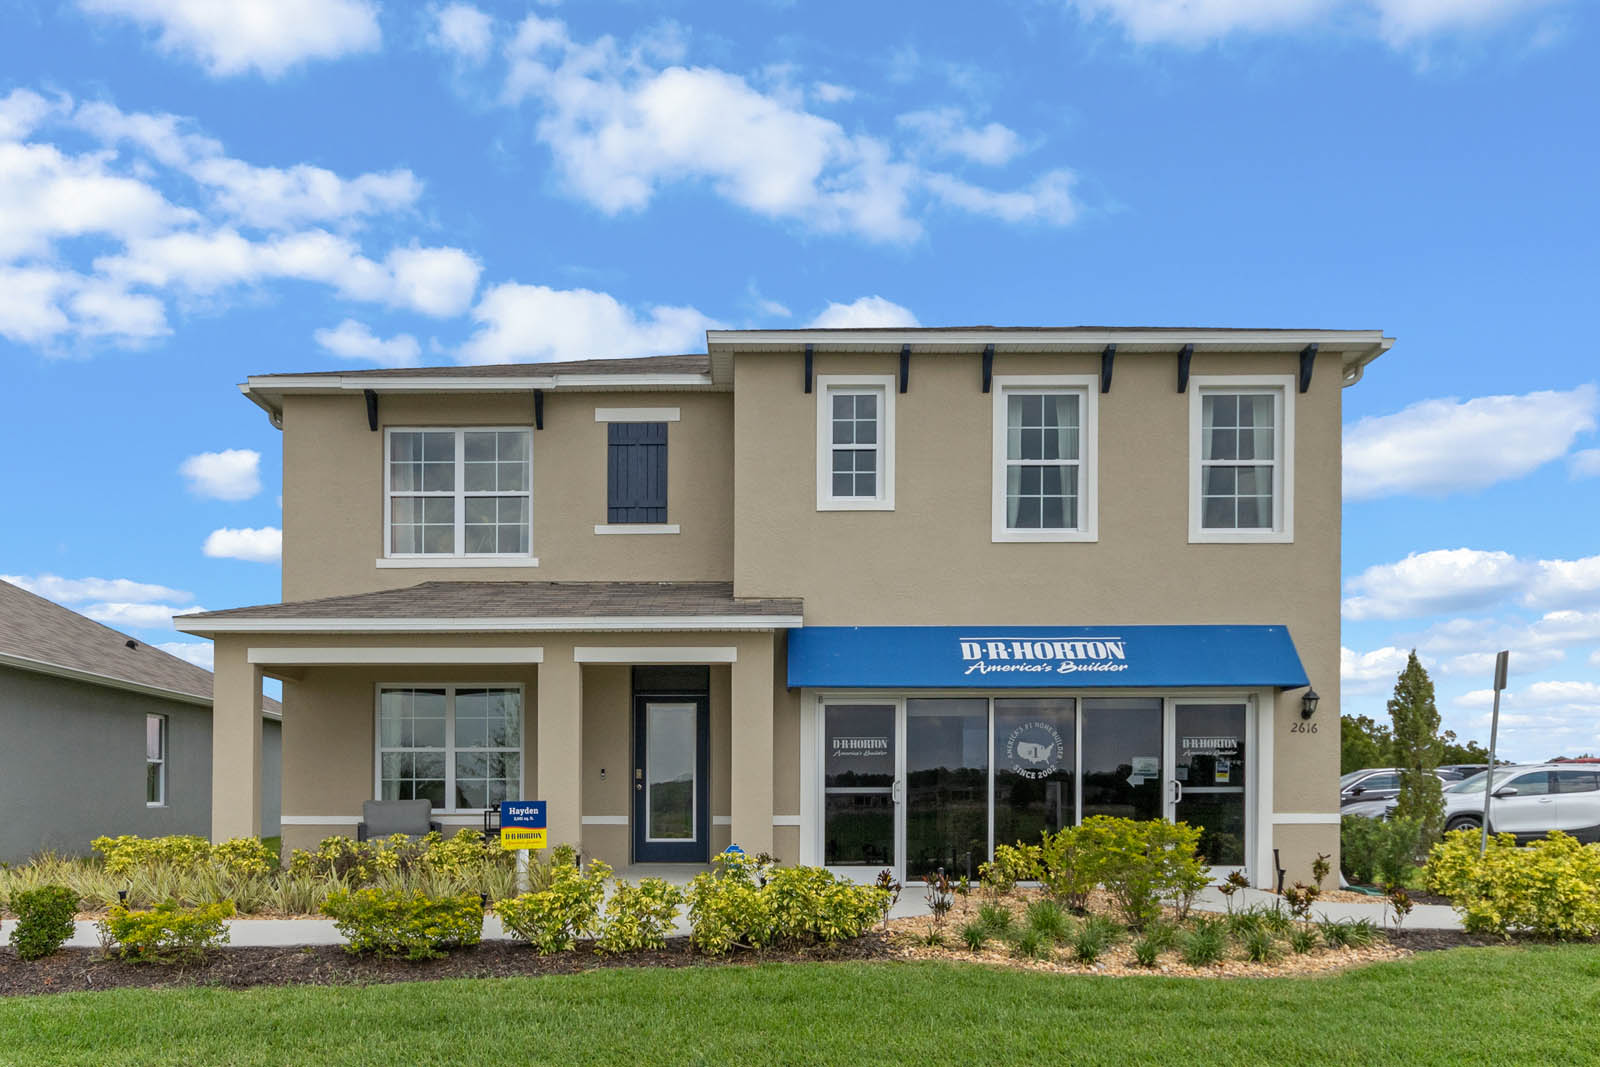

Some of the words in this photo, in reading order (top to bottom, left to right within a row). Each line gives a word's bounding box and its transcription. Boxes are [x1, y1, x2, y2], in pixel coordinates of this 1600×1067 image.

[964, 660, 1053, 675] America's
[1056, 660, 1129, 674] Builder
[1290, 722, 1318, 734] 2616
[1012, 764, 1036, 779] SINCE
[1037, 764, 1057, 779] 2002
[509, 807, 539, 816] Hayden
